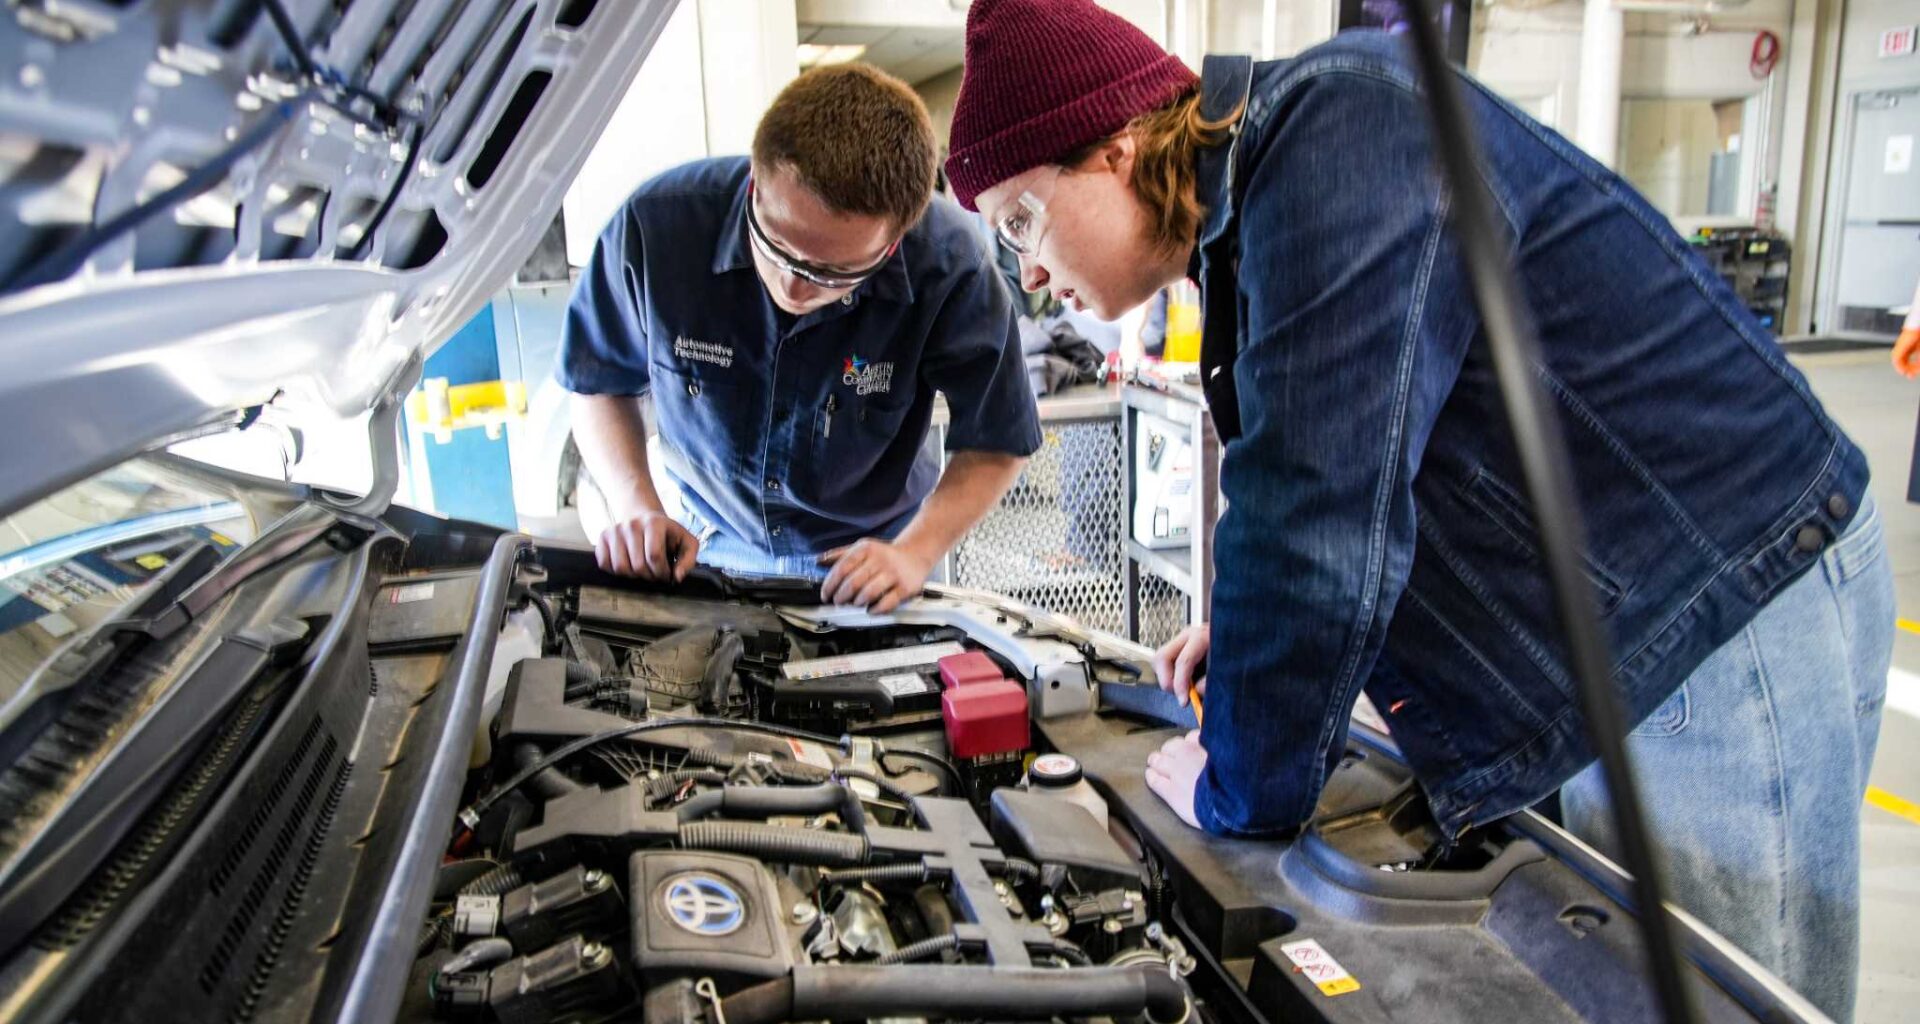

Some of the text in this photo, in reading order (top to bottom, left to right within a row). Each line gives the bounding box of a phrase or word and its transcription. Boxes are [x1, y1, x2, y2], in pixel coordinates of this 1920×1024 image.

[1884, 29, 1910, 53] EXIT
[674, 335, 734, 357] Automotive
[674, 347, 733, 368] Technology
[843, 373, 892, 386] COMTY
